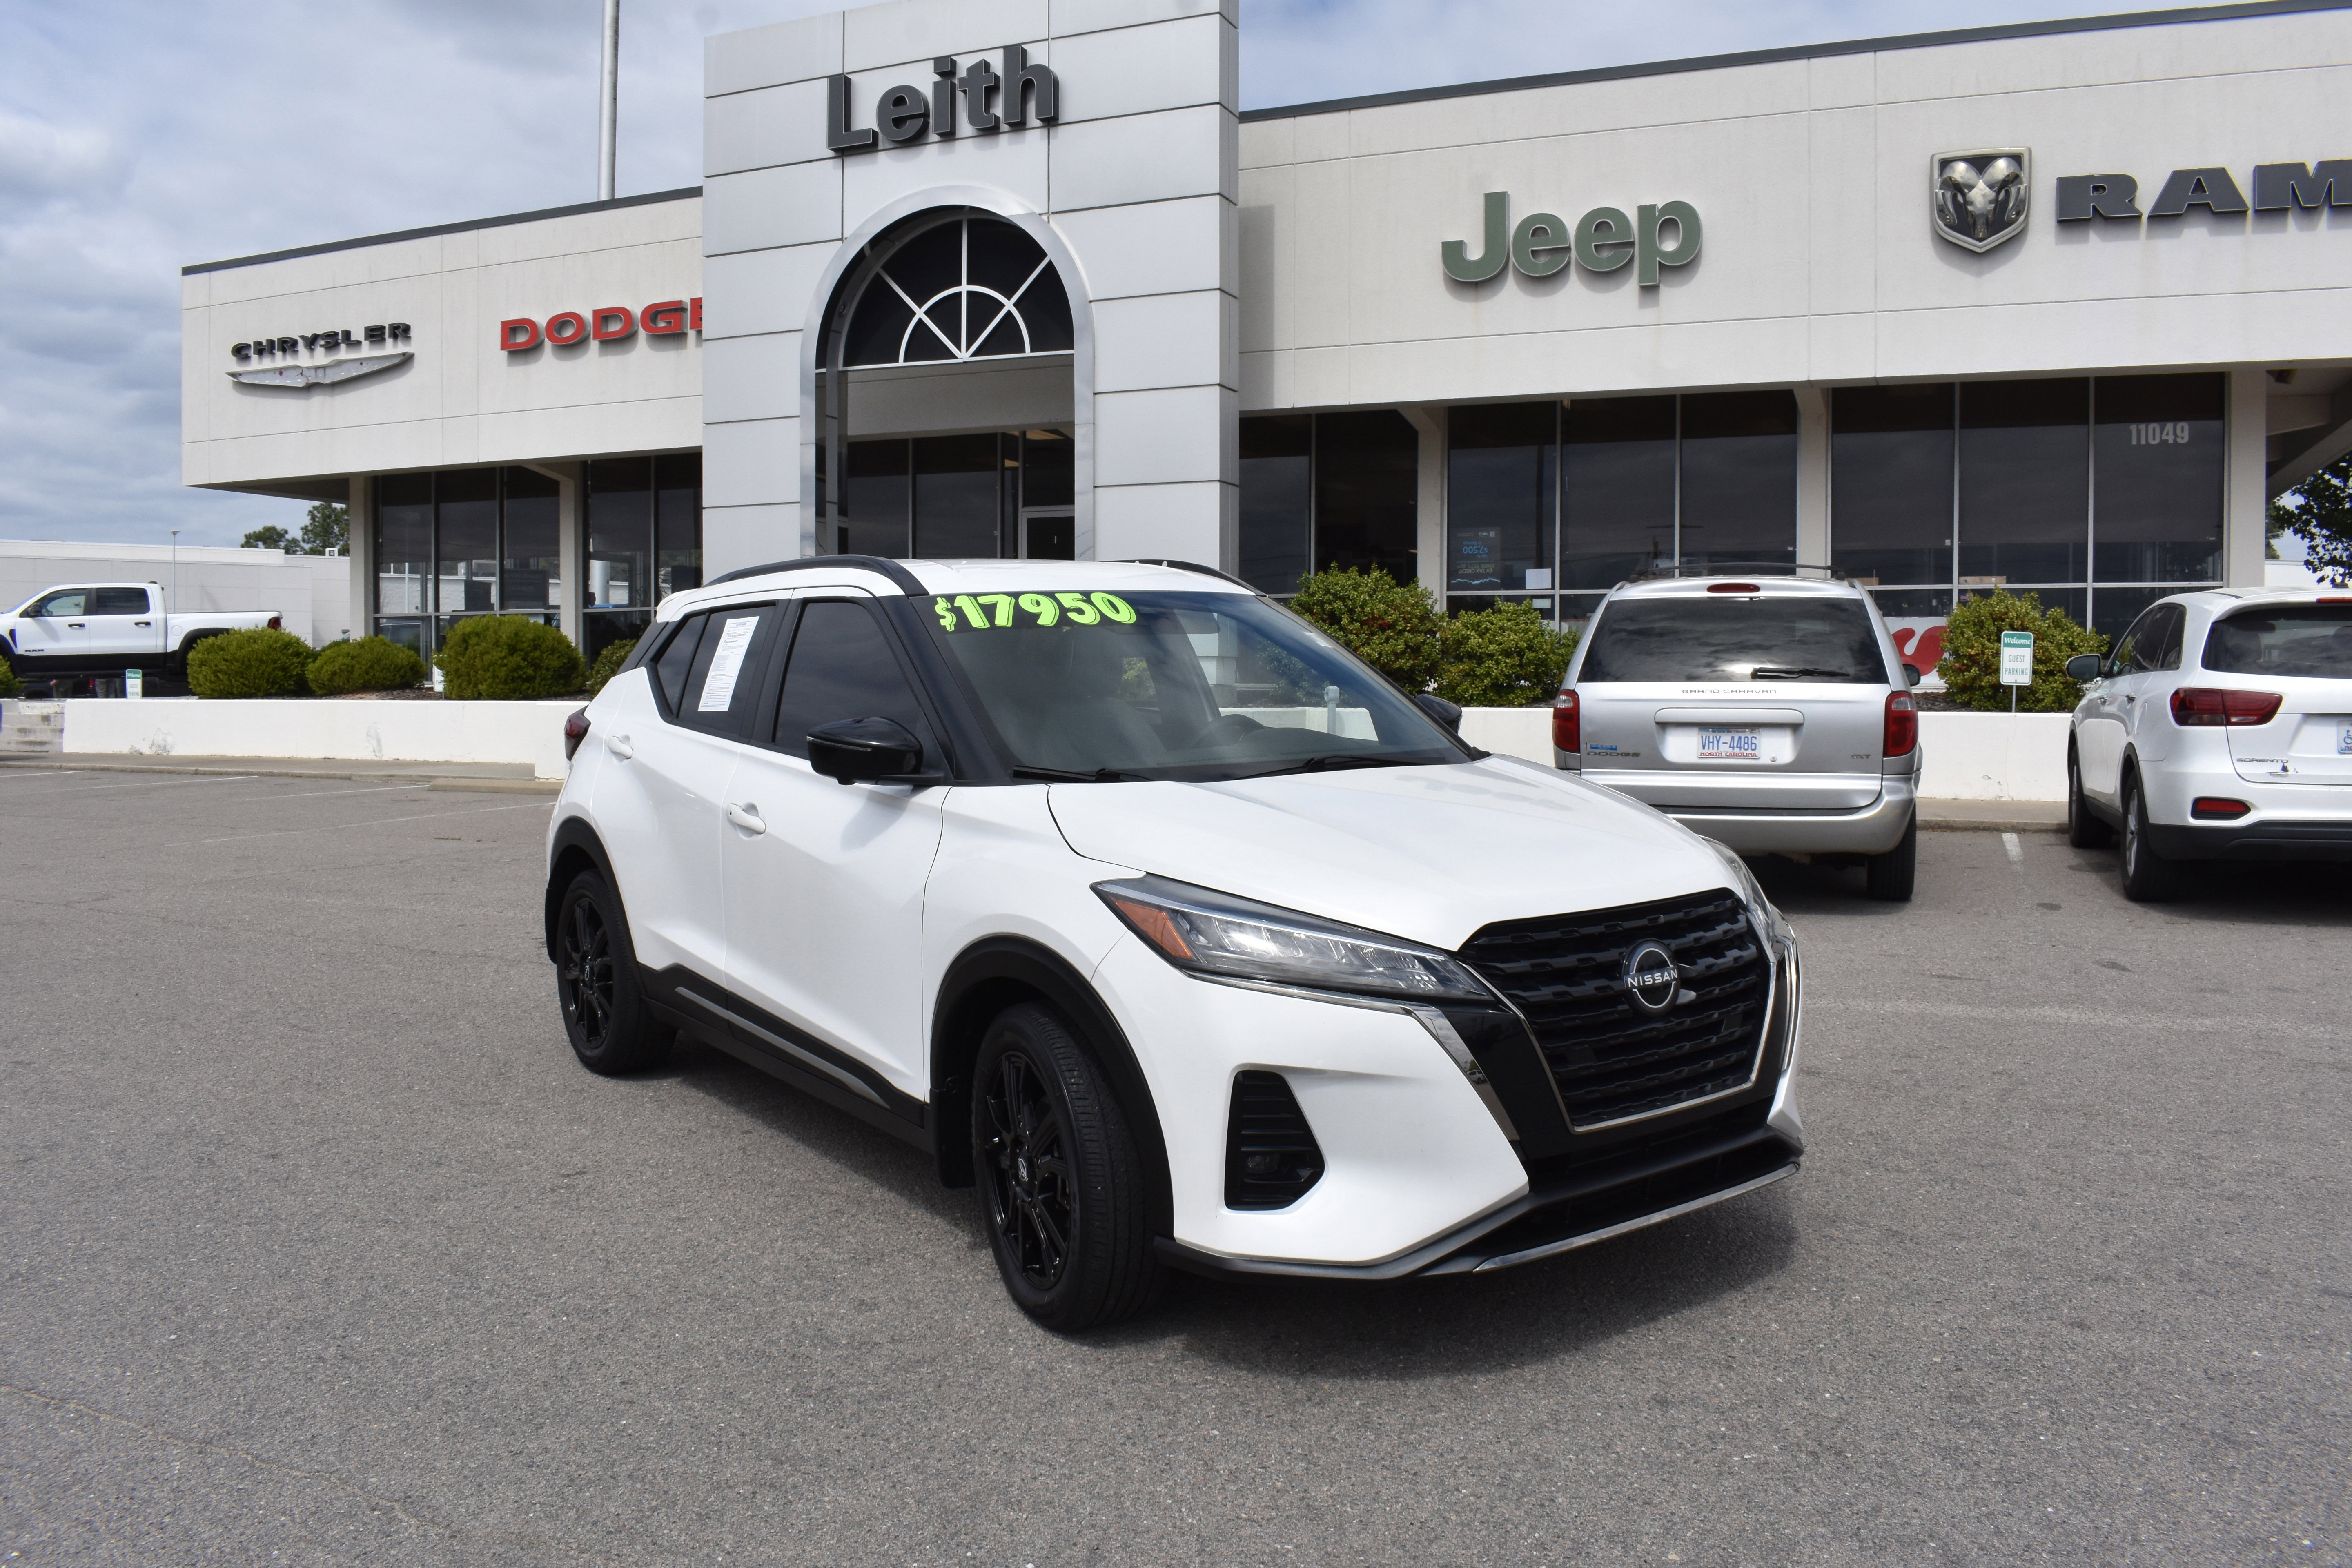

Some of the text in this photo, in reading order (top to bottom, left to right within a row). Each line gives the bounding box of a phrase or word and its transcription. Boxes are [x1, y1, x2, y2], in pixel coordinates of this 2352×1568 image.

[827, 45, 1059, 151] Leith
[2056, 158, 2352, 222] RAM
[1441, 191, 1702, 288] Jeep
[231, 322, 411, 359] CHRYSLER
[2129, 422, 2189, 445] 11049
[1463, 546, 1488, 554] $7,500
[935, 592, 1137, 632] $17950
[2009, 655, 2025, 663] GUEST
[2005, 668, 2028, 676] PARKING
[1701, 735, 1757, 751] VHY-4486
[1628, 969, 1677, 987] NISSAN
